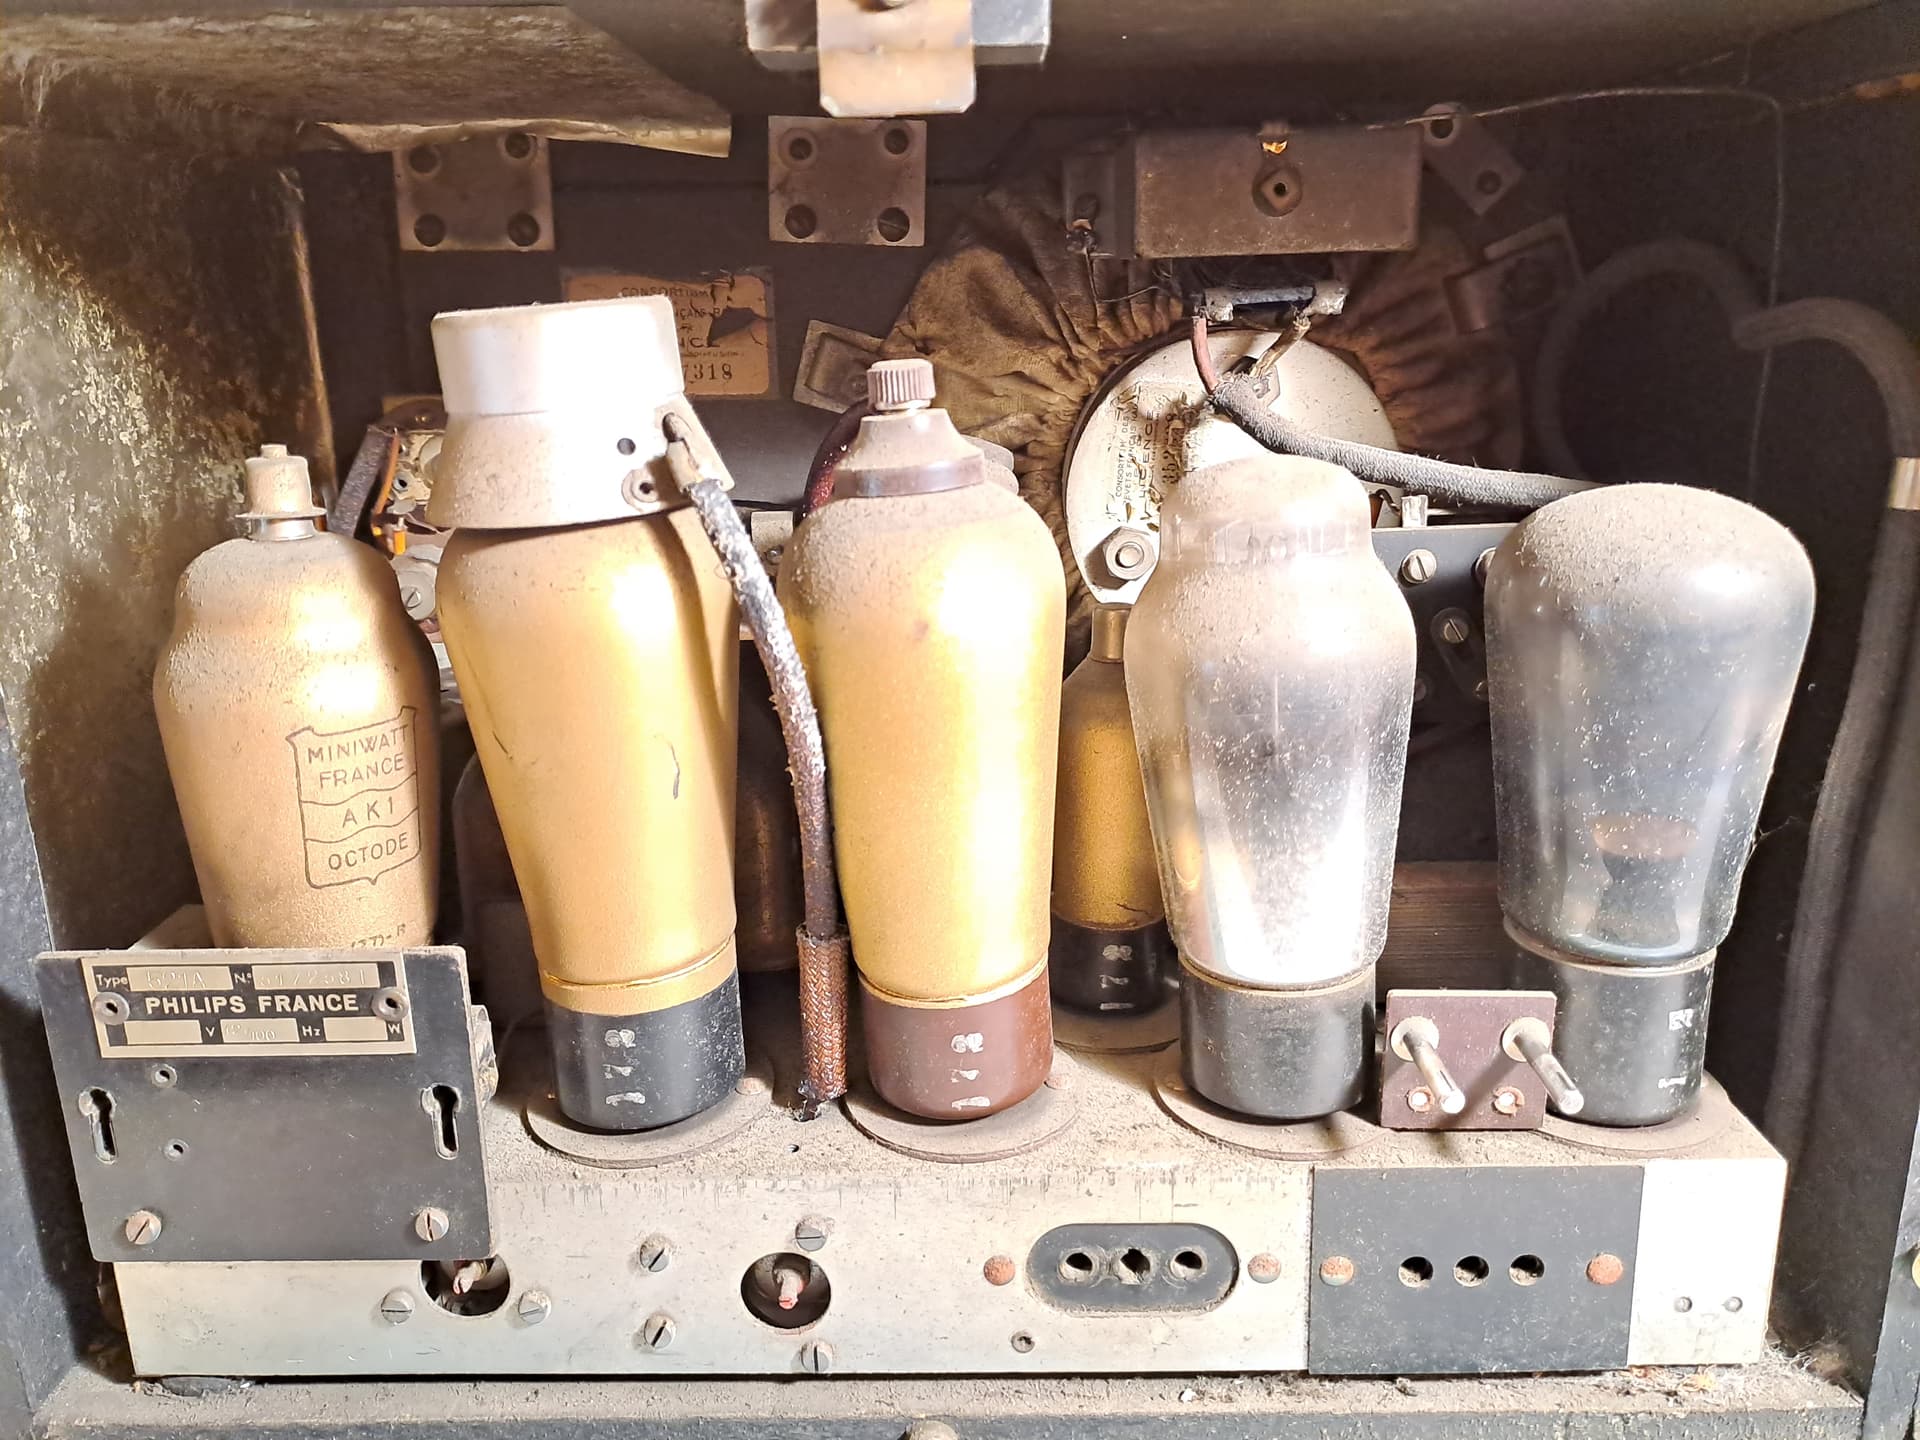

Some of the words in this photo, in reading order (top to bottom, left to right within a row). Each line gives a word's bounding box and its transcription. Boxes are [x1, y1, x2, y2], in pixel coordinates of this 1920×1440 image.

[307, 724, 409, 764] MINIWATT
[319, 753, 405, 789] FRANCE
[328, 832, 409, 870] OCTODE
[96, 973, 128, 990] Type
[145, 996, 246, 1014] PHILIPS
[258, 994, 359, 1012] FRANCE
[302, 1025, 321, 1037] Hz
